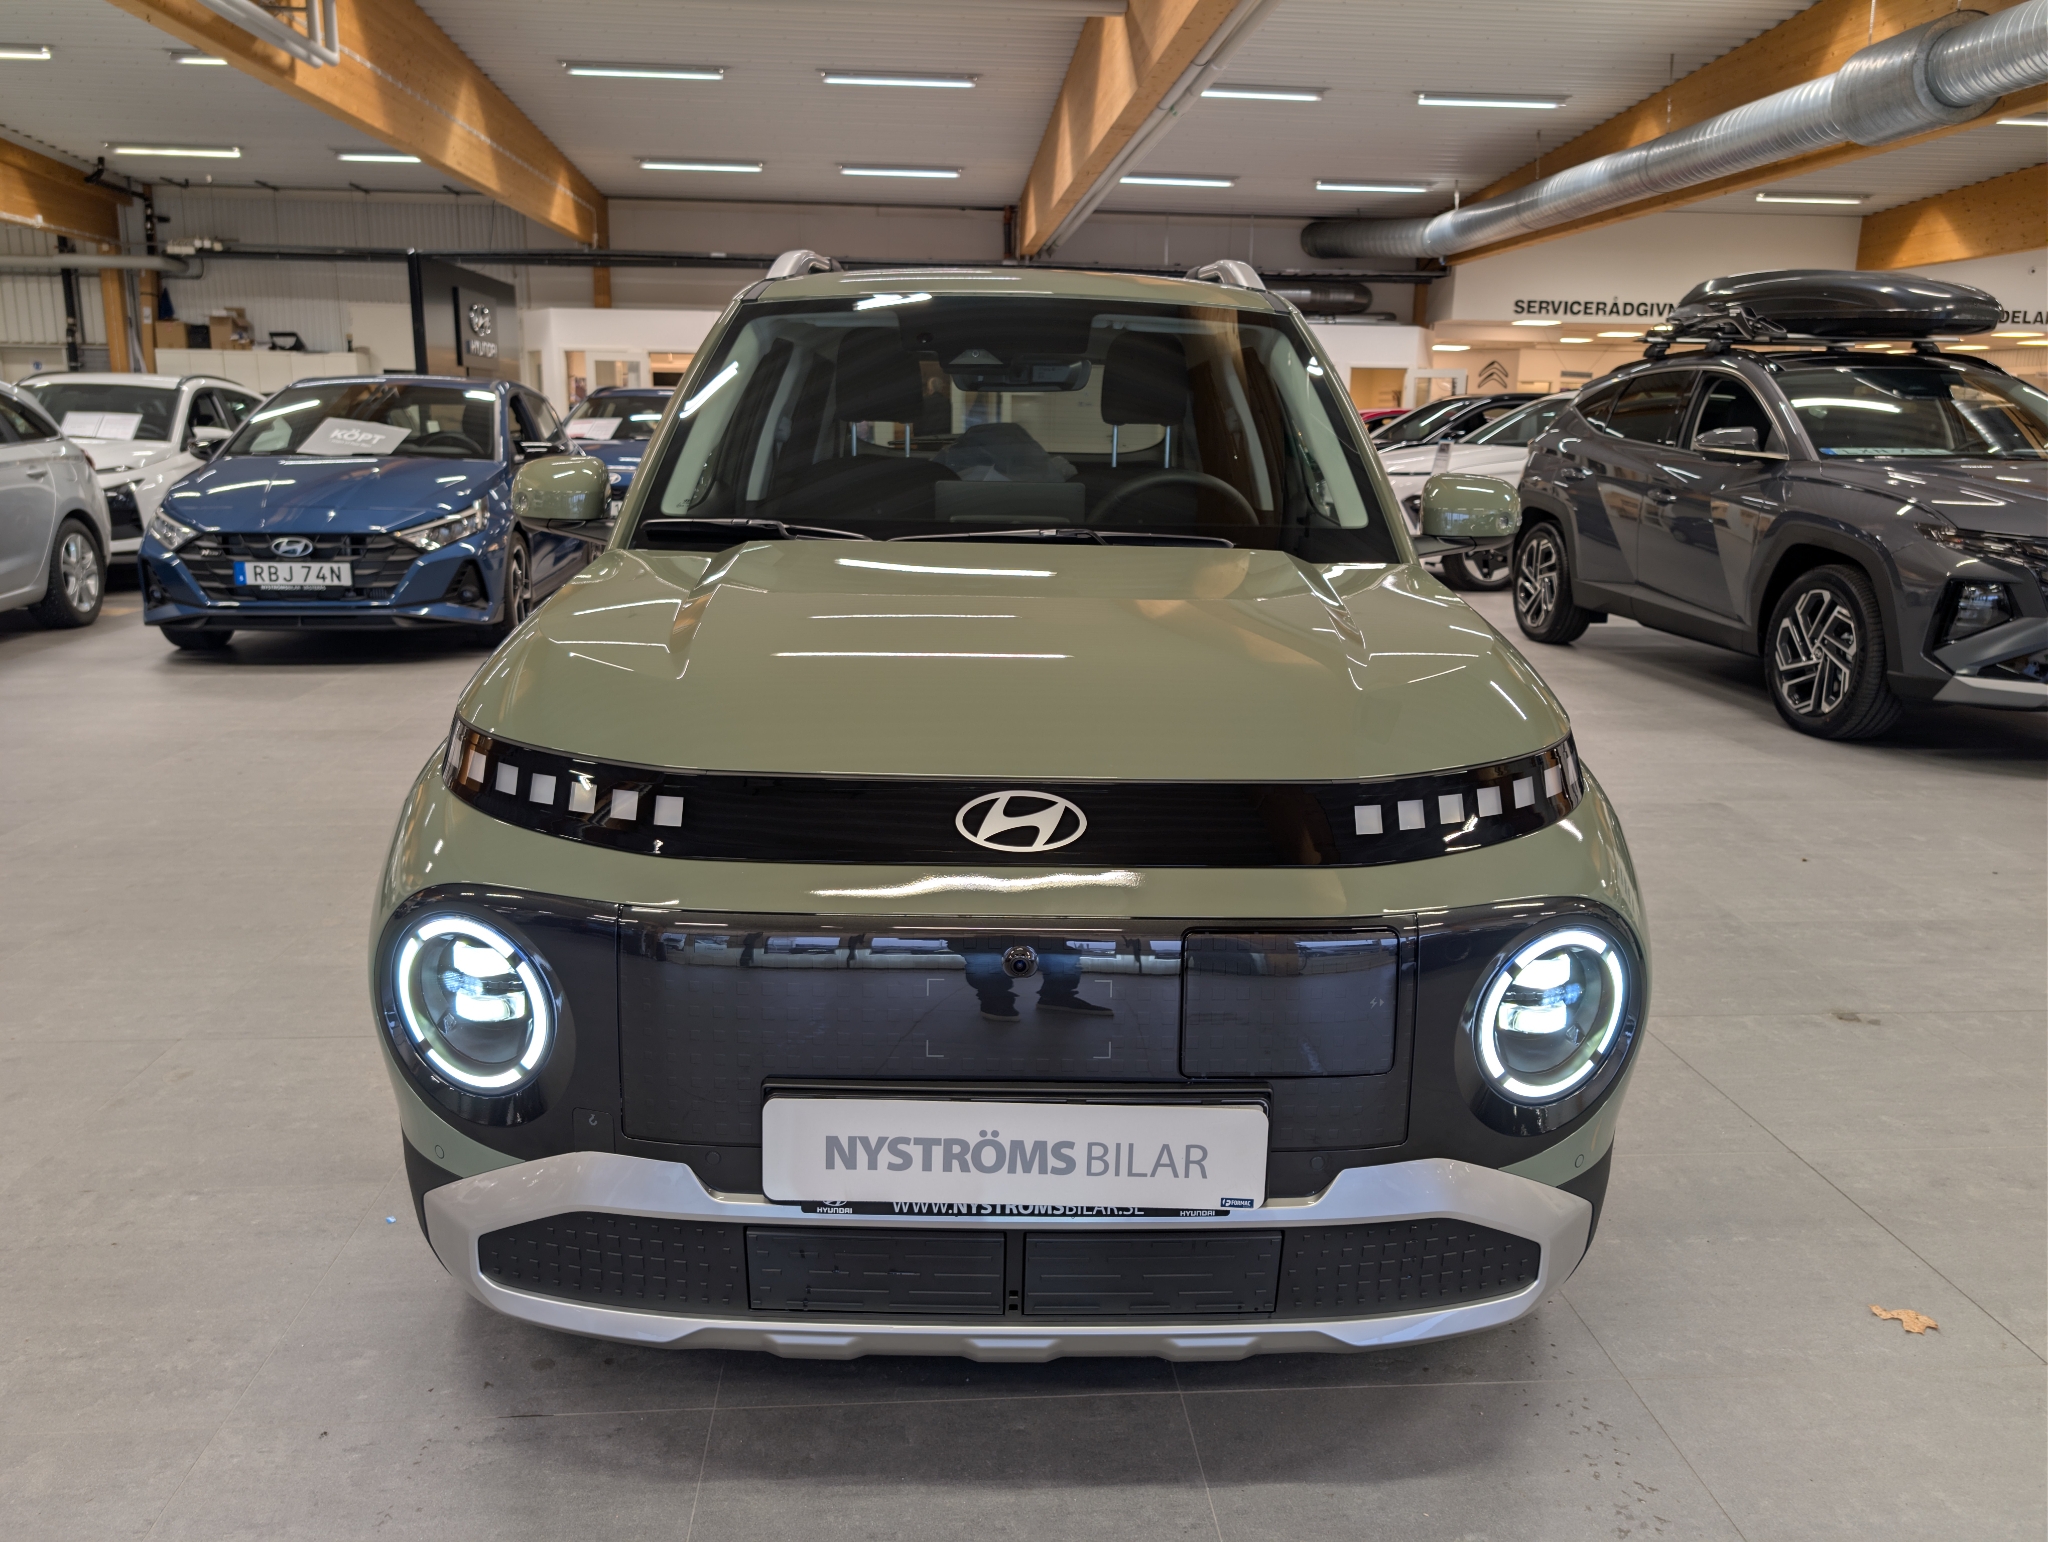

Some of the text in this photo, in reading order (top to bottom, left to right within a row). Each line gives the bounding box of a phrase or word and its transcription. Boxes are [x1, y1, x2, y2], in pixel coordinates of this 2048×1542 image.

[1998, 310, 2048, 325] DELA
[329, 427, 386, 445] KÖPT
[253, 565, 342, 583] RBJ 74N
[825, 1129, 1209, 1180] NYSTRÖMS BILAR
[816, 1206, 853, 1214] HYUNDAI
[1179, 1209, 1216, 1217] HYUNDAI
